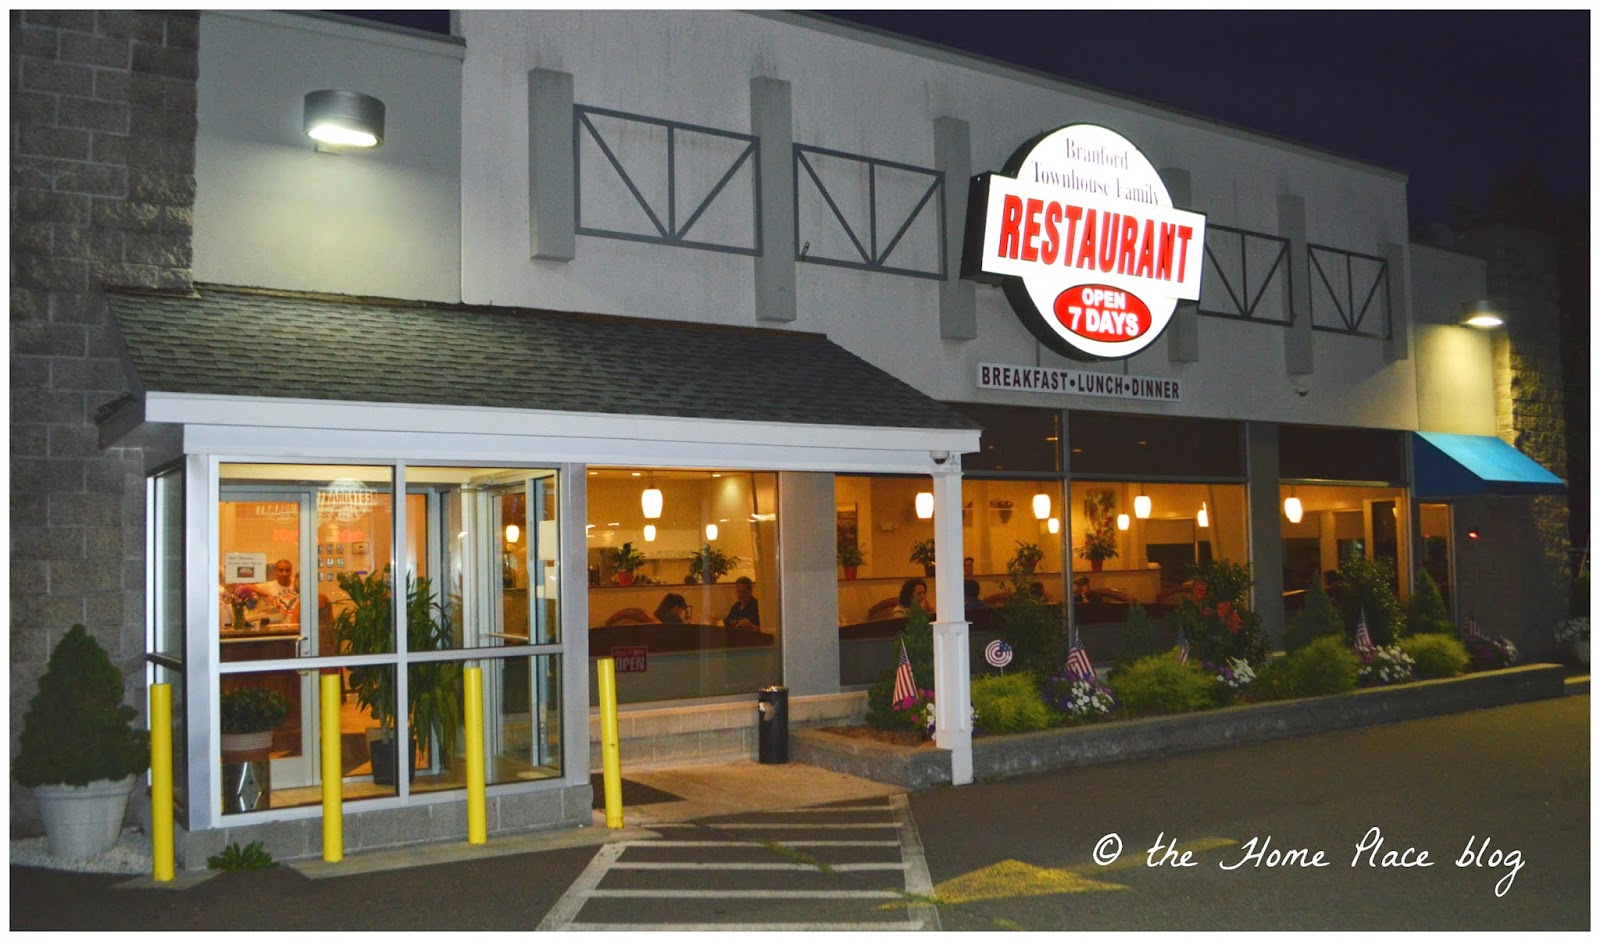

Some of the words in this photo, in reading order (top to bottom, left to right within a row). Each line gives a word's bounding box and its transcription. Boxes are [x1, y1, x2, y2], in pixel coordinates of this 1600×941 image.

[1066, 138, 1128, 170] Branford
[1031, 160, 1109, 196] Townhouse
[1116, 178, 1159, 208] Family
[998, 194, 1193, 283] RESTAURANT
[1082, 287, 1126, 310] OPEN
[1068, 306, 1082, 331] 7
[1085, 308, 1139, 337] DAYS
[615, 656, 645, 671] OPEN
